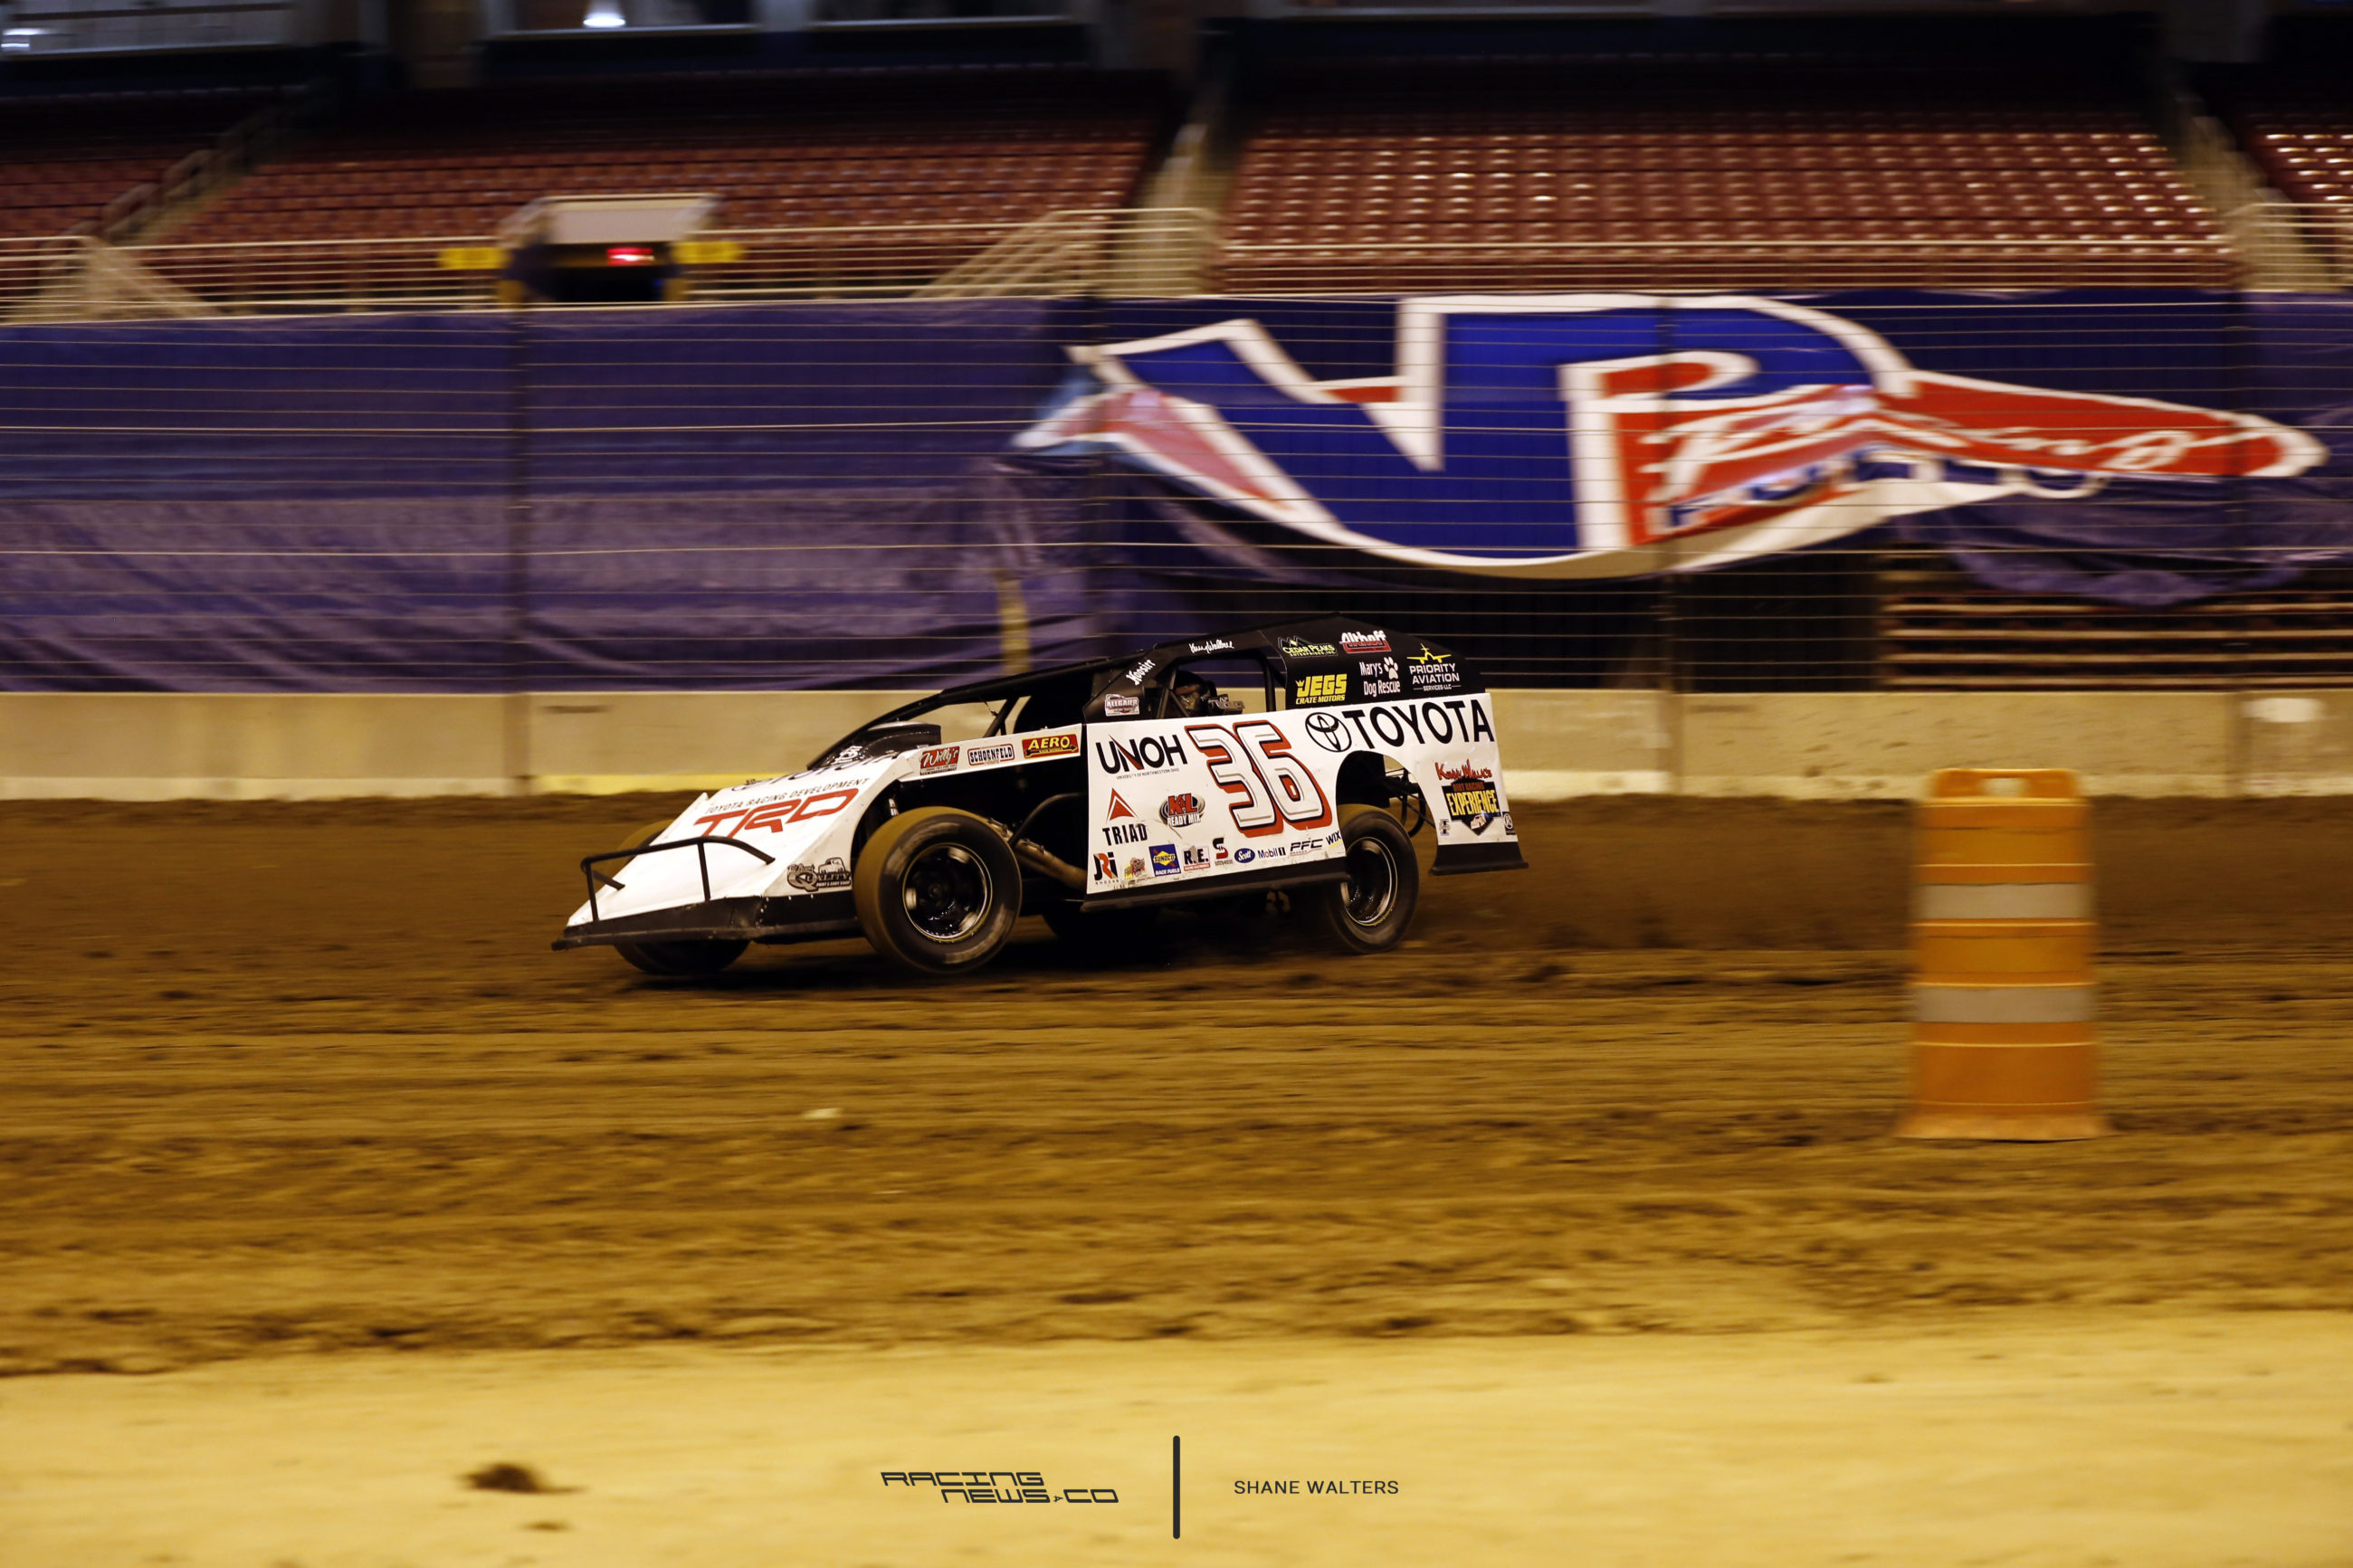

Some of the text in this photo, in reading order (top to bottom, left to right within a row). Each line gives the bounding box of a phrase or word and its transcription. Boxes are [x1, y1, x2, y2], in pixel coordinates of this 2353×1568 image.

[1339, 630, 1386, 642] Althoff
[1409, 663, 1455, 674] PRIORITY
[1297, 674, 1347, 697] JEGS
[1413, 673, 1460, 684] AVIATION
[1364, 680, 1401, 698] Dog Rescue
[1296, 694, 1345, 705] CRATE MOTORS
[1341, 699, 1494, 749] TOYOTA
[1028, 736, 1070, 750] AERO
[919, 748, 958, 767] Willy's
[969, 746, 1013, 763] SCHOENFELD
[1095, 734, 1188, 774] UNOH
[1185, 720, 1332, 838] 36
[747, 793, 787, 806] RACING
[789, 778, 870, 799] DEVELOPMENT
[1446, 790, 1500, 816] EXPERIENCE
[693, 788, 859, 838] TRD
[1167, 813, 1201, 826] READY MIX
[1102, 823, 1148, 846] TRIAD
[1326, 831, 1341, 845] WIX
[1290, 839, 1323, 851] PFC
[1154, 854, 1176, 862] SUNOCO
[1257, 849, 1278, 859] Mobil
